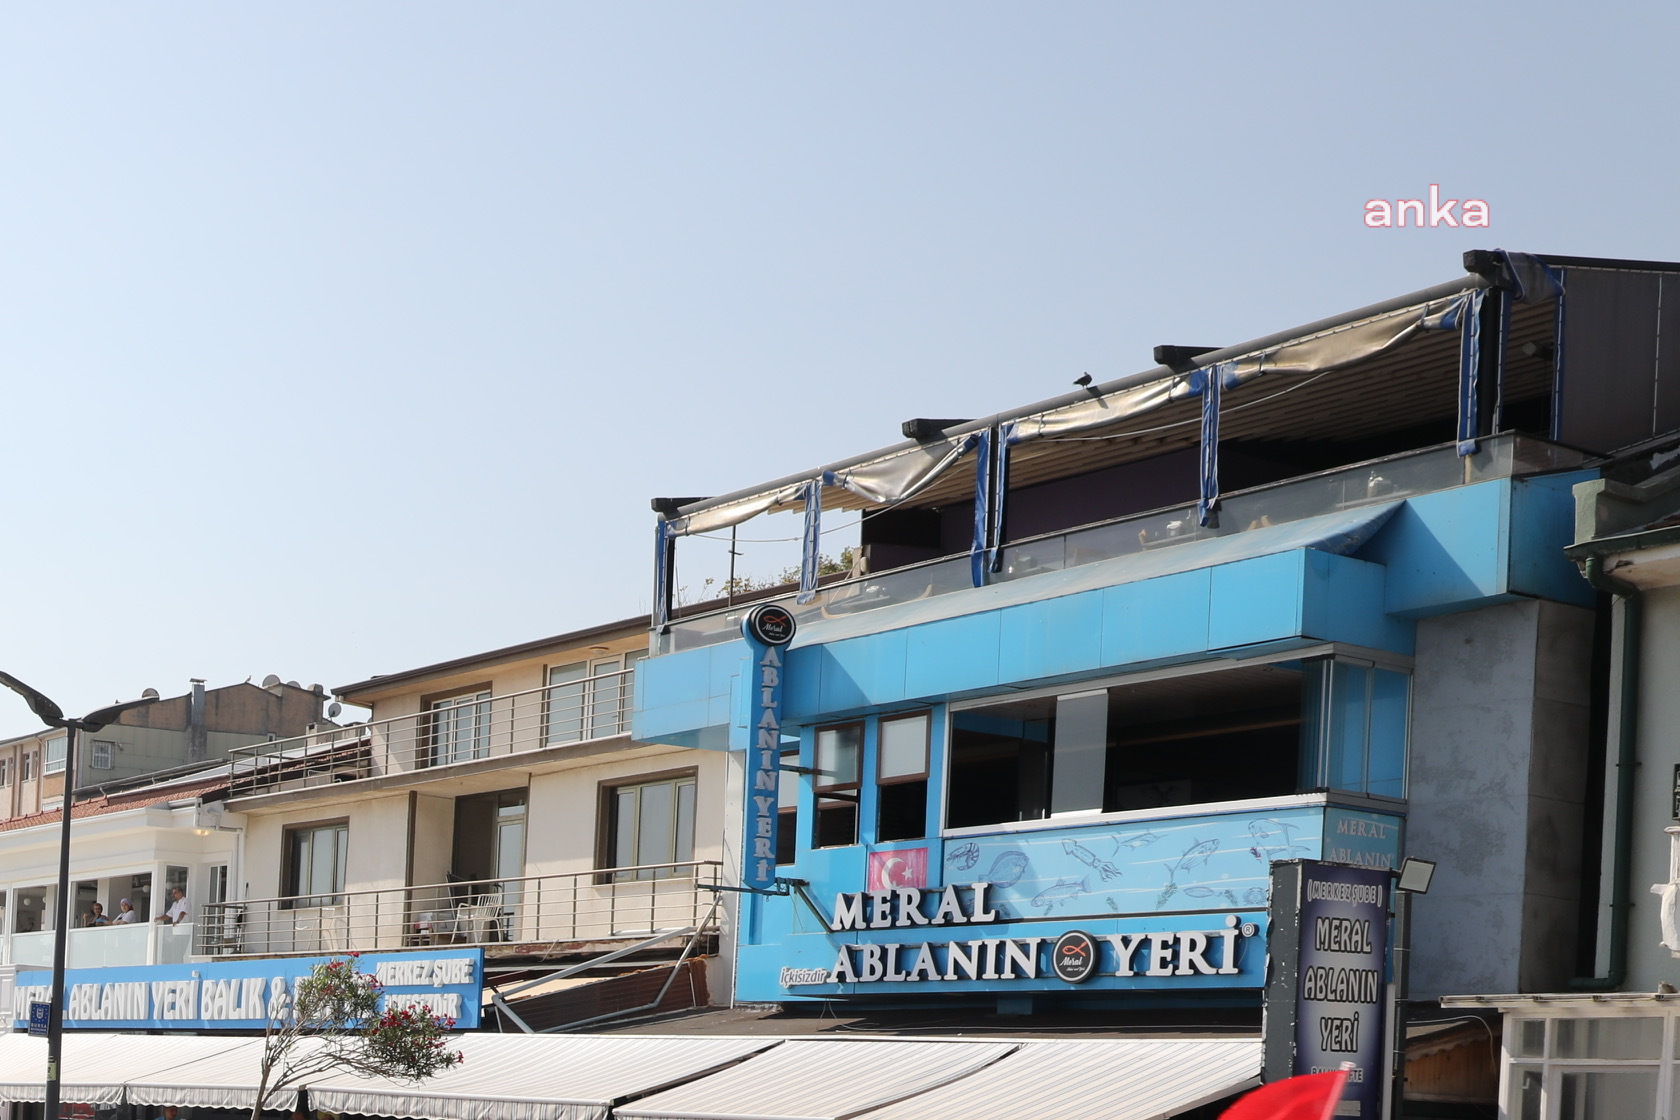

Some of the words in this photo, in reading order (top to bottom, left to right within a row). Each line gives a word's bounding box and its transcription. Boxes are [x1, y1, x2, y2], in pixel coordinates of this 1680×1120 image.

[754, 646, 782, 791] ABLANIN
[1337, 819, 1387, 839] MERAL
[1329, 847, 1394, 869] ABLANIN
[830, 882, 996, 931] MERAL
[825, 937, 1042, 983] ABLANIN
[1106, 914, 1240, 977] YERİ
[1315, 917, 1372, 954] MERAL
[376, 960, 434, 986] MERKEZ
[433, 958, 474, 988] ŞUBE
[1304, 966, 1379, 1003] ABLANIN
[68, 982, 149, 1021] ABLANIN
[152, 970, 200, 1020] YERİ
[201, 977, 267, 1021] BALIK
[268, 976, 291, 1020] &
[1320, 1011, 1360, 1052] YERİ
